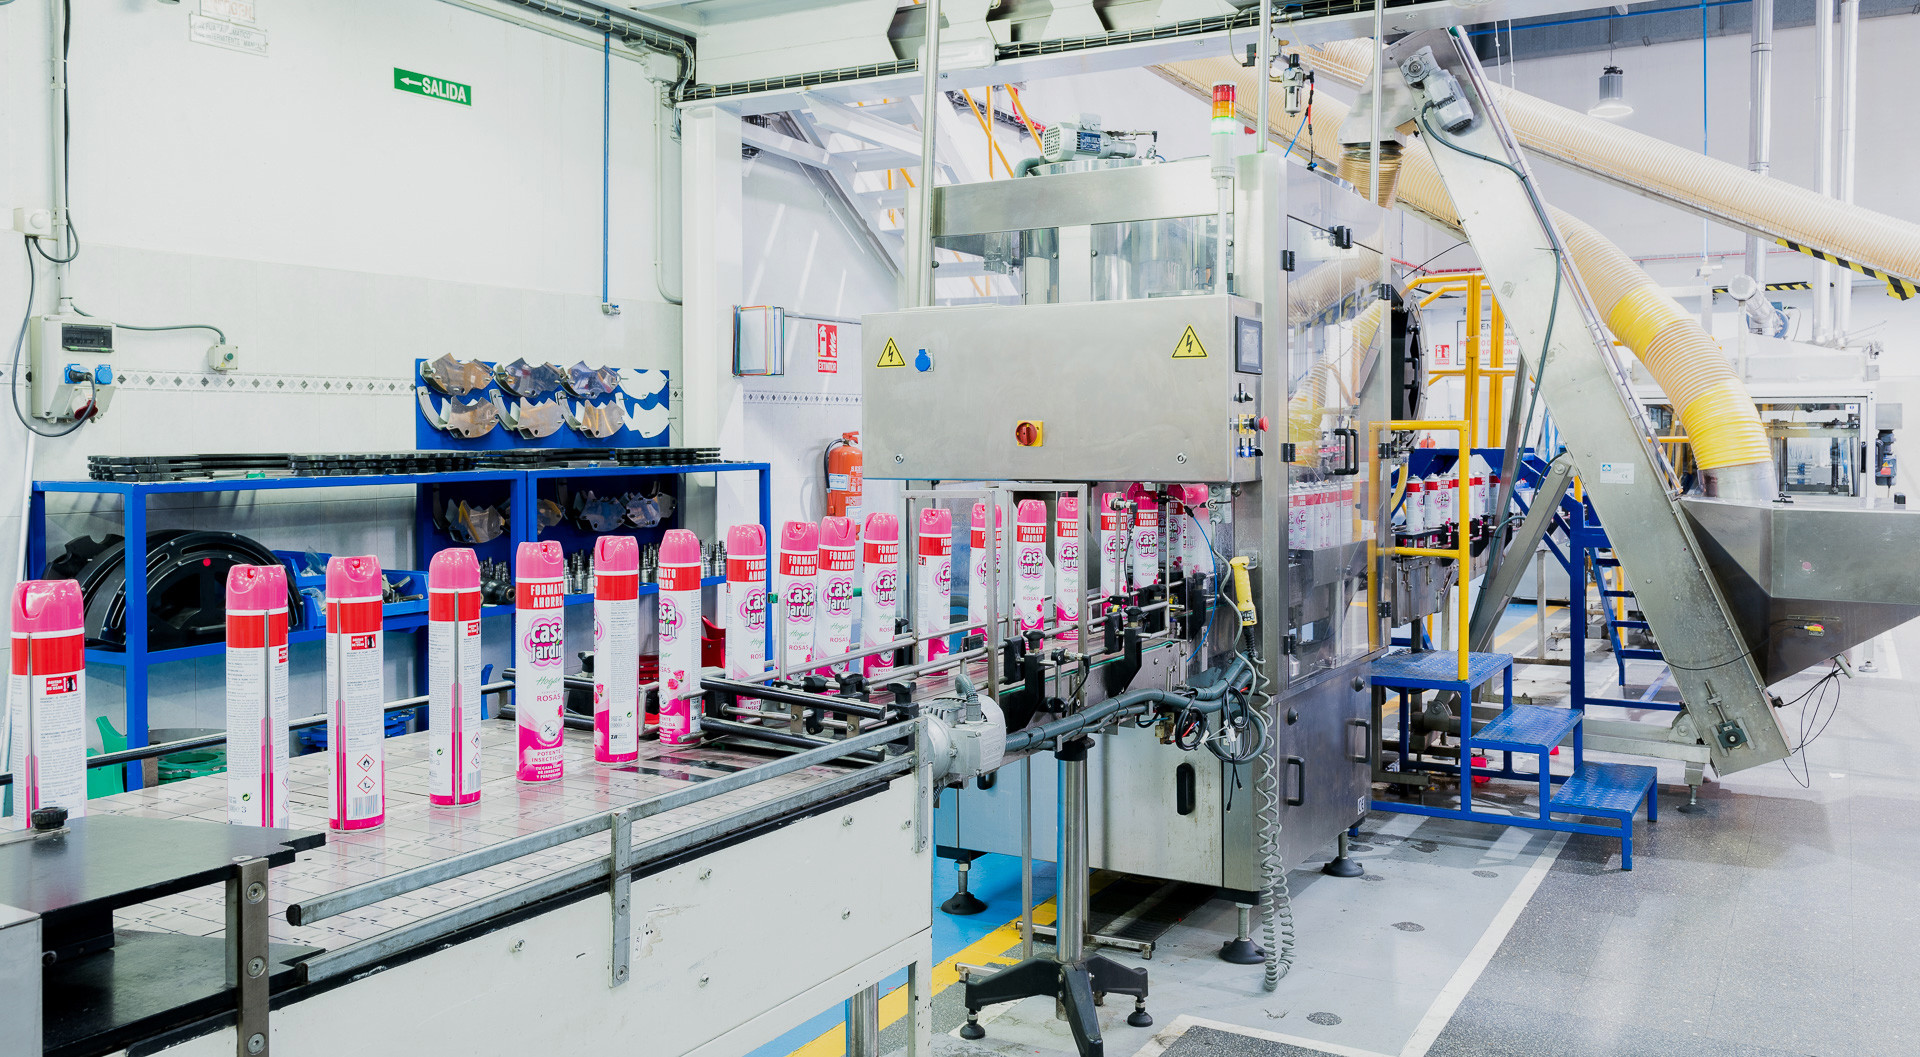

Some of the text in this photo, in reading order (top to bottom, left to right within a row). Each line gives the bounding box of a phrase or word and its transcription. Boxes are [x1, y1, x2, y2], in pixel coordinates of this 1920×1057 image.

[422, 77, 466, 102] SALIDA
[1021, 552, 1042, 564] casa
[1061, 546, 1078, 558] cas
[746, 561, 766, 570] FORMA
[876, 576, 896, 589] cas
[533, 596, 563, 608] AHORR
[788, 588, 814, 603] casa
[876, 589, 895, 604] jard
[746, 594, 765, 611] cas
[659, 605, 676, 621] asa
[745, 611, 764, 627] jard
[536, 694, 561, 702] ROSAS
[532, 754, 564, 762] INSECTICID
